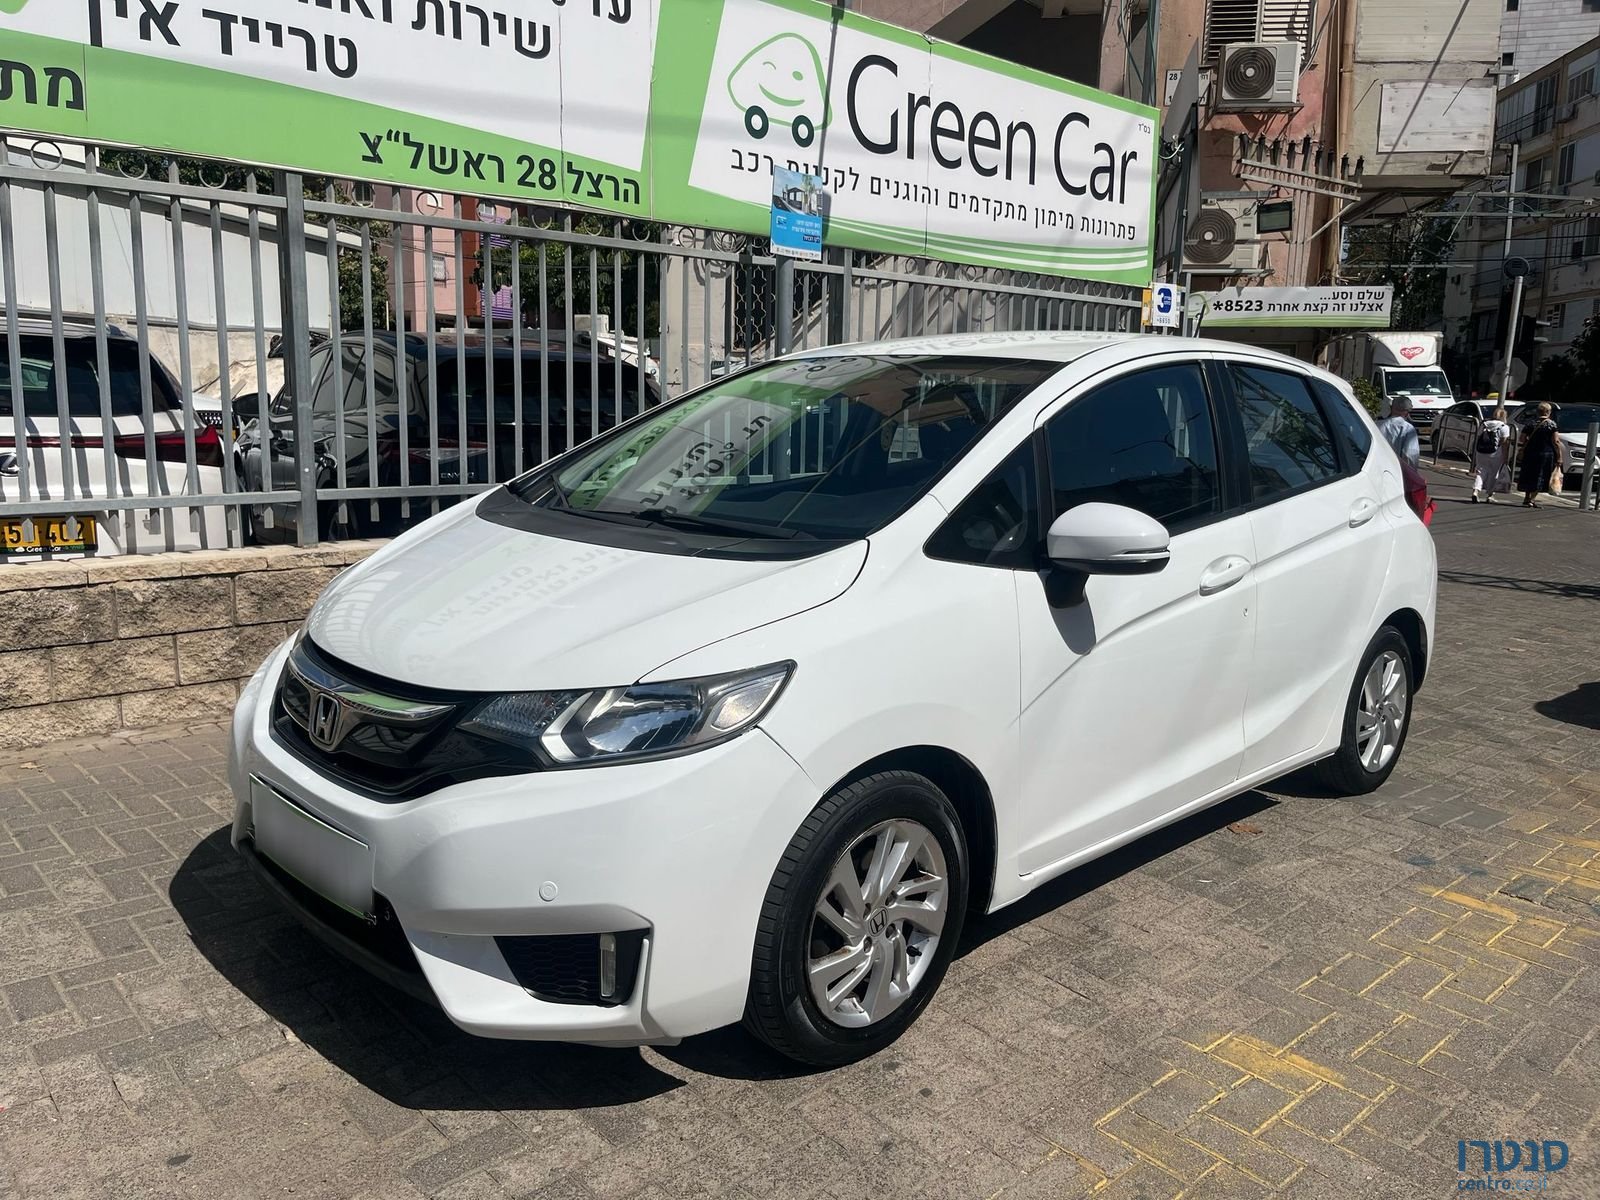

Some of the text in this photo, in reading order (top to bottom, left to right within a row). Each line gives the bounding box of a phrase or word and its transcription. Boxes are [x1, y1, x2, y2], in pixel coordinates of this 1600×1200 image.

[88, 0, 181, 47] אין
[411, 0, 551, 59] שירות
[202, 8, 358, 78] טרייד
[1169, 73, 1178, 81] 28
[847, 55, 1137, 204] Green Car
[517, 155, 556, 190] 28
[731, 149, 774, 175] רכב
[567, 161, 640, 204] הרצל
[870, 176, 939, 206] והוגנים
[949, 191, 1027, 221] מתקדמים
[1035, 207, 1074, 229] מימון
[1080, 216, 1136, 240] פתרונות
[1267, 303, 1300, 312] אחרת
[1332, 302, 1346, 311] זה
[1349, 302, 1384, 311] אצלנו
[1357, 290, 1384, 300] שלם
[1303, 303, 1329, 314] קצת
